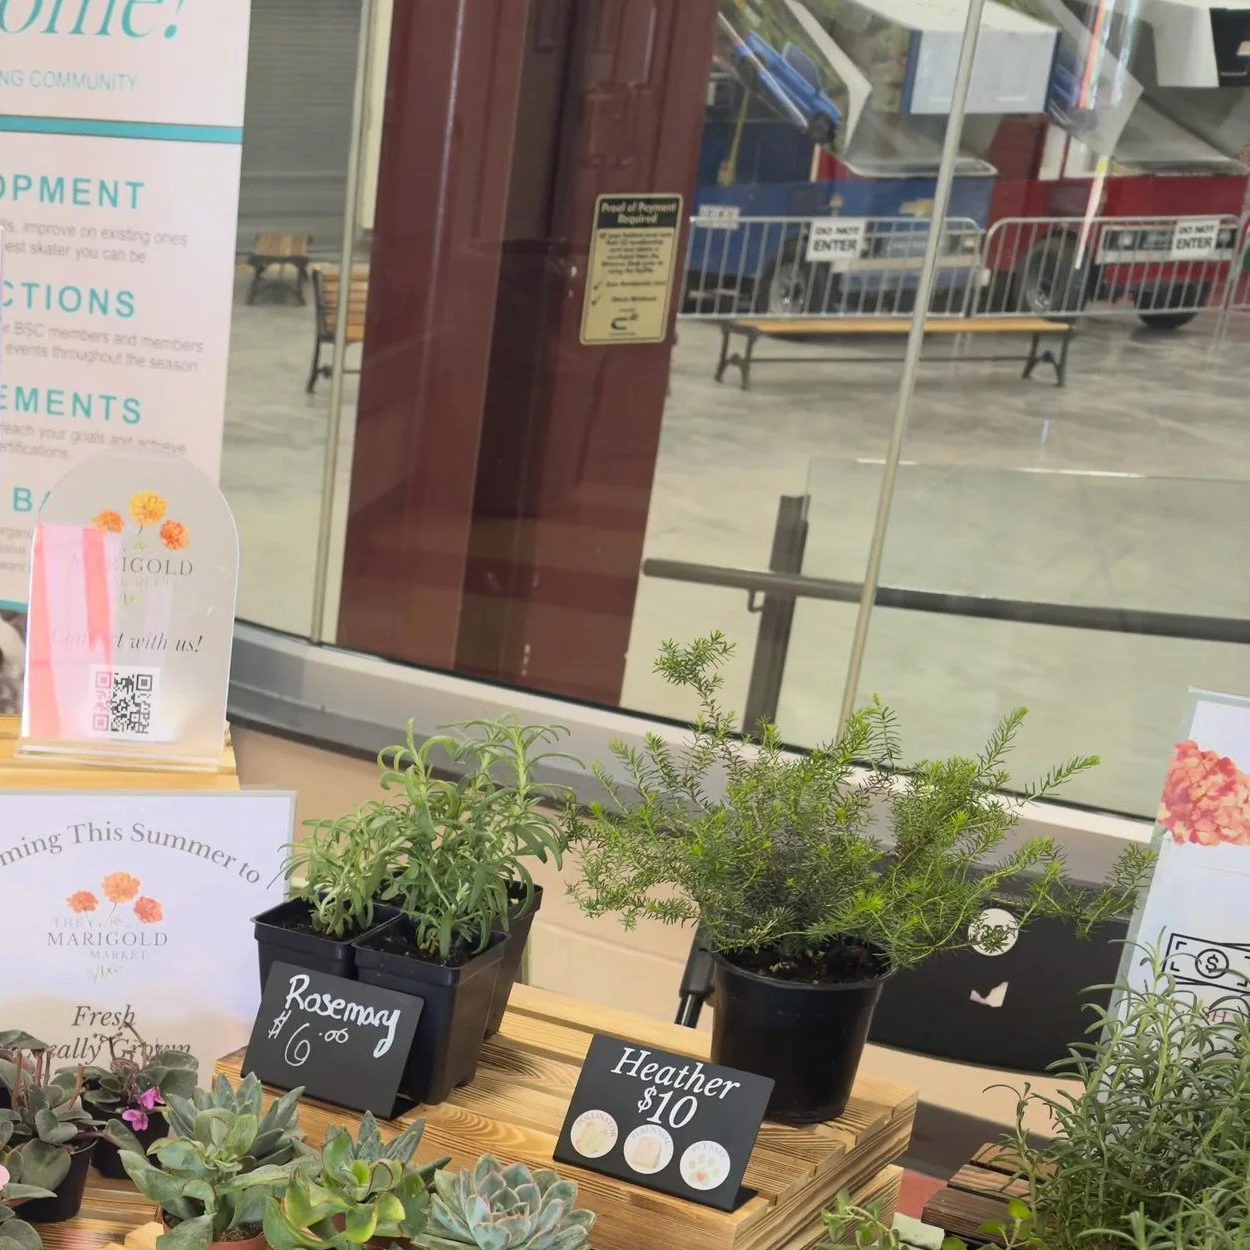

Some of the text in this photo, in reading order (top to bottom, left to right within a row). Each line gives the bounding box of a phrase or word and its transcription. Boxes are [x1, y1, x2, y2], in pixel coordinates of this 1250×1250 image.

[29, 70, 137, 91] COMMUNITY
[601, 203, 676, 213] Proof Payment
[618, 214, 658, 224] Required
[1195, 225, 1215, 233] NOT
[23, 223, 76, 239] improve
[101, 227, 150, 246] existing
[815, 226, 860, 236] DO NOT
[31, 242, 126, 262] skater can
[814, 239, 857, 251] ENTER
[1176, 237, 1213, 249] ENTER
[15, 321, 203, 352] BSC members and members
[53, 345, 123, 365] throughout
[150, 357, 198, 373] season
[71, 430, 105, 445] goals
[131, 632, 203, 653] with us!
[66, 820, 123, 846] This
[130, 822, 237, 869] Summer
[238, 861, 261, 884] to
[46, 931, 168, 948] MARIGOLD
[89, 950, 149, 961] MARKET
[71, 1004, 135, 1027] Fresh
[284, 973, 403, 1058] Rosemary
[609, 1045, 742, 1102] Heather
[637, 1085, 700, 1130] $10
